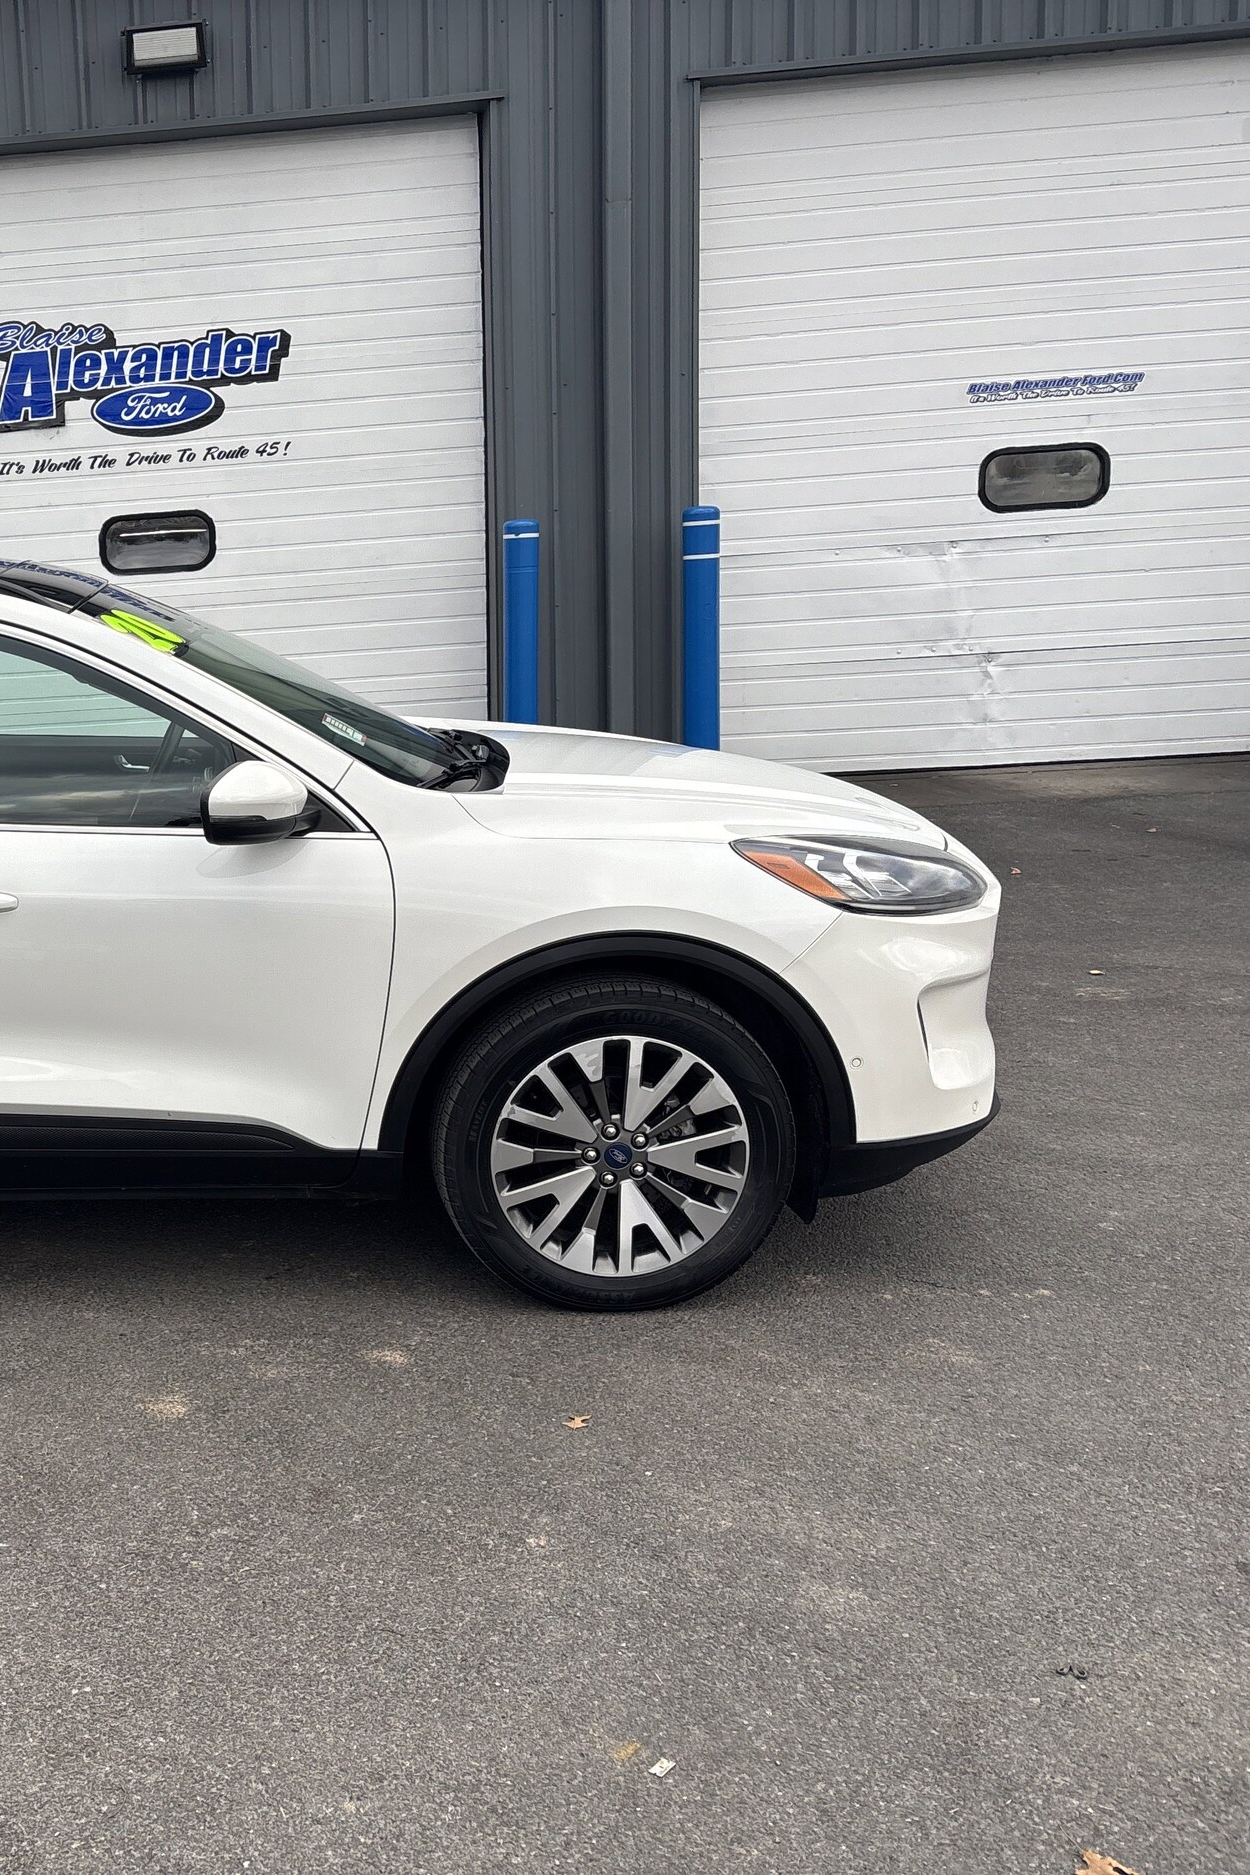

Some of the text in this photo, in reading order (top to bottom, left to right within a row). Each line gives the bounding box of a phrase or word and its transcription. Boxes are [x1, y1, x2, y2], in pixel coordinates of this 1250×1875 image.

[966, 382, 1011, 394] Blaise
[1012, 376, 1081, 391] Alexander
[120, 394, 187, 420] Ford
[32, 456, 82, 474] Worth
[88, 454, 116, 469] The
[126, 451, 172, 467] Drive
[177, 448, 197, 463] To
[203, 445, 249, 461] Route
